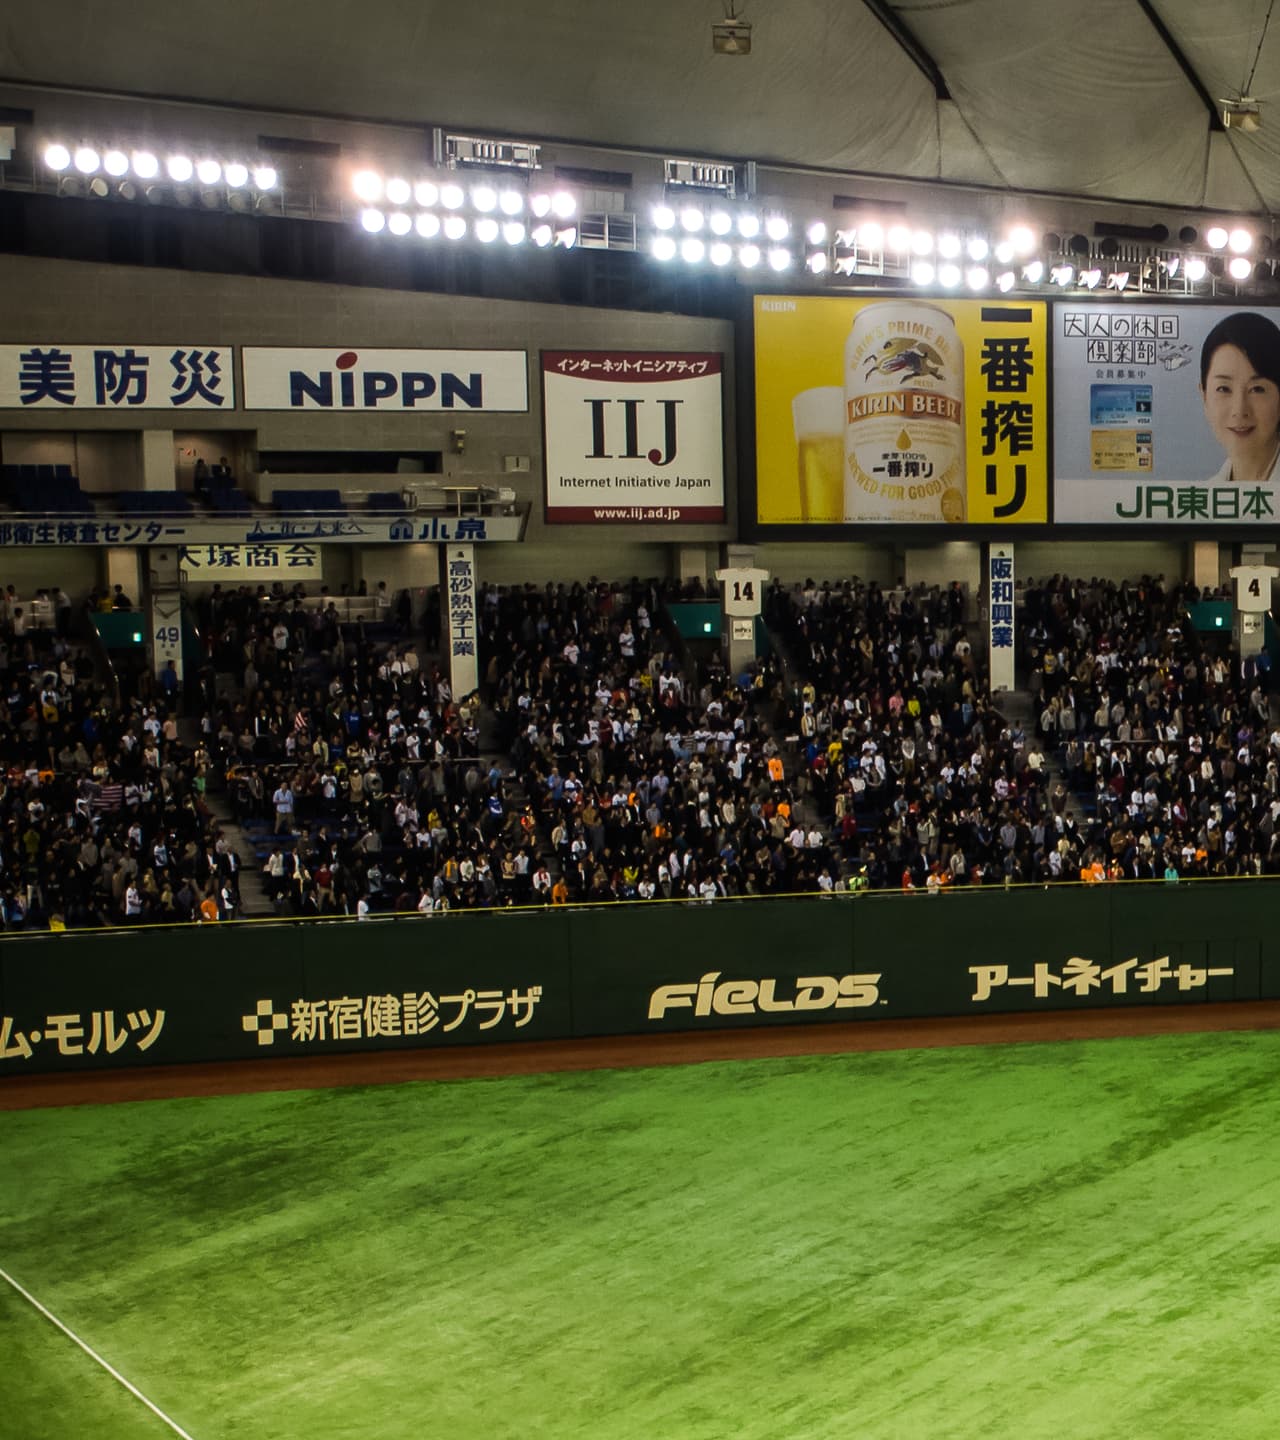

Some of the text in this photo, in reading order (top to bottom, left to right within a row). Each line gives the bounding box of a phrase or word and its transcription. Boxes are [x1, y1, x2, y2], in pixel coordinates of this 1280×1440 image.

[18, 348, 226, 407] 美防災
[557, 358, 708, 374] インターネットイニシアティブ
[851, 393, 955, 418] KIRIN BEER
[980, 306, 1034, 518] 一番搾り
[584, 399, 684, 466] IIJ
[872, 461, 934, 478] 一番搾り
[560, 476, 711, 489] Internet Initiative Japan
[594, 507, 680, 520] www.iij.ad.jp
[1115, 486, 1274, 520] JR東日本
[419, 518, 486, 540] 小泉
[733, 581, 754, 601] 14
[1247, 578, 1261, 598] 4
[450, 559, 474, 657] 高砂熱学工業
[991, 558, 1014, 647] 阪和興業
[156, 627, 180, 642] 49
[968, 954, 1234, 1001] アートネイチャー
[290, 985, 543, 1043] 新宿健診プラザ
